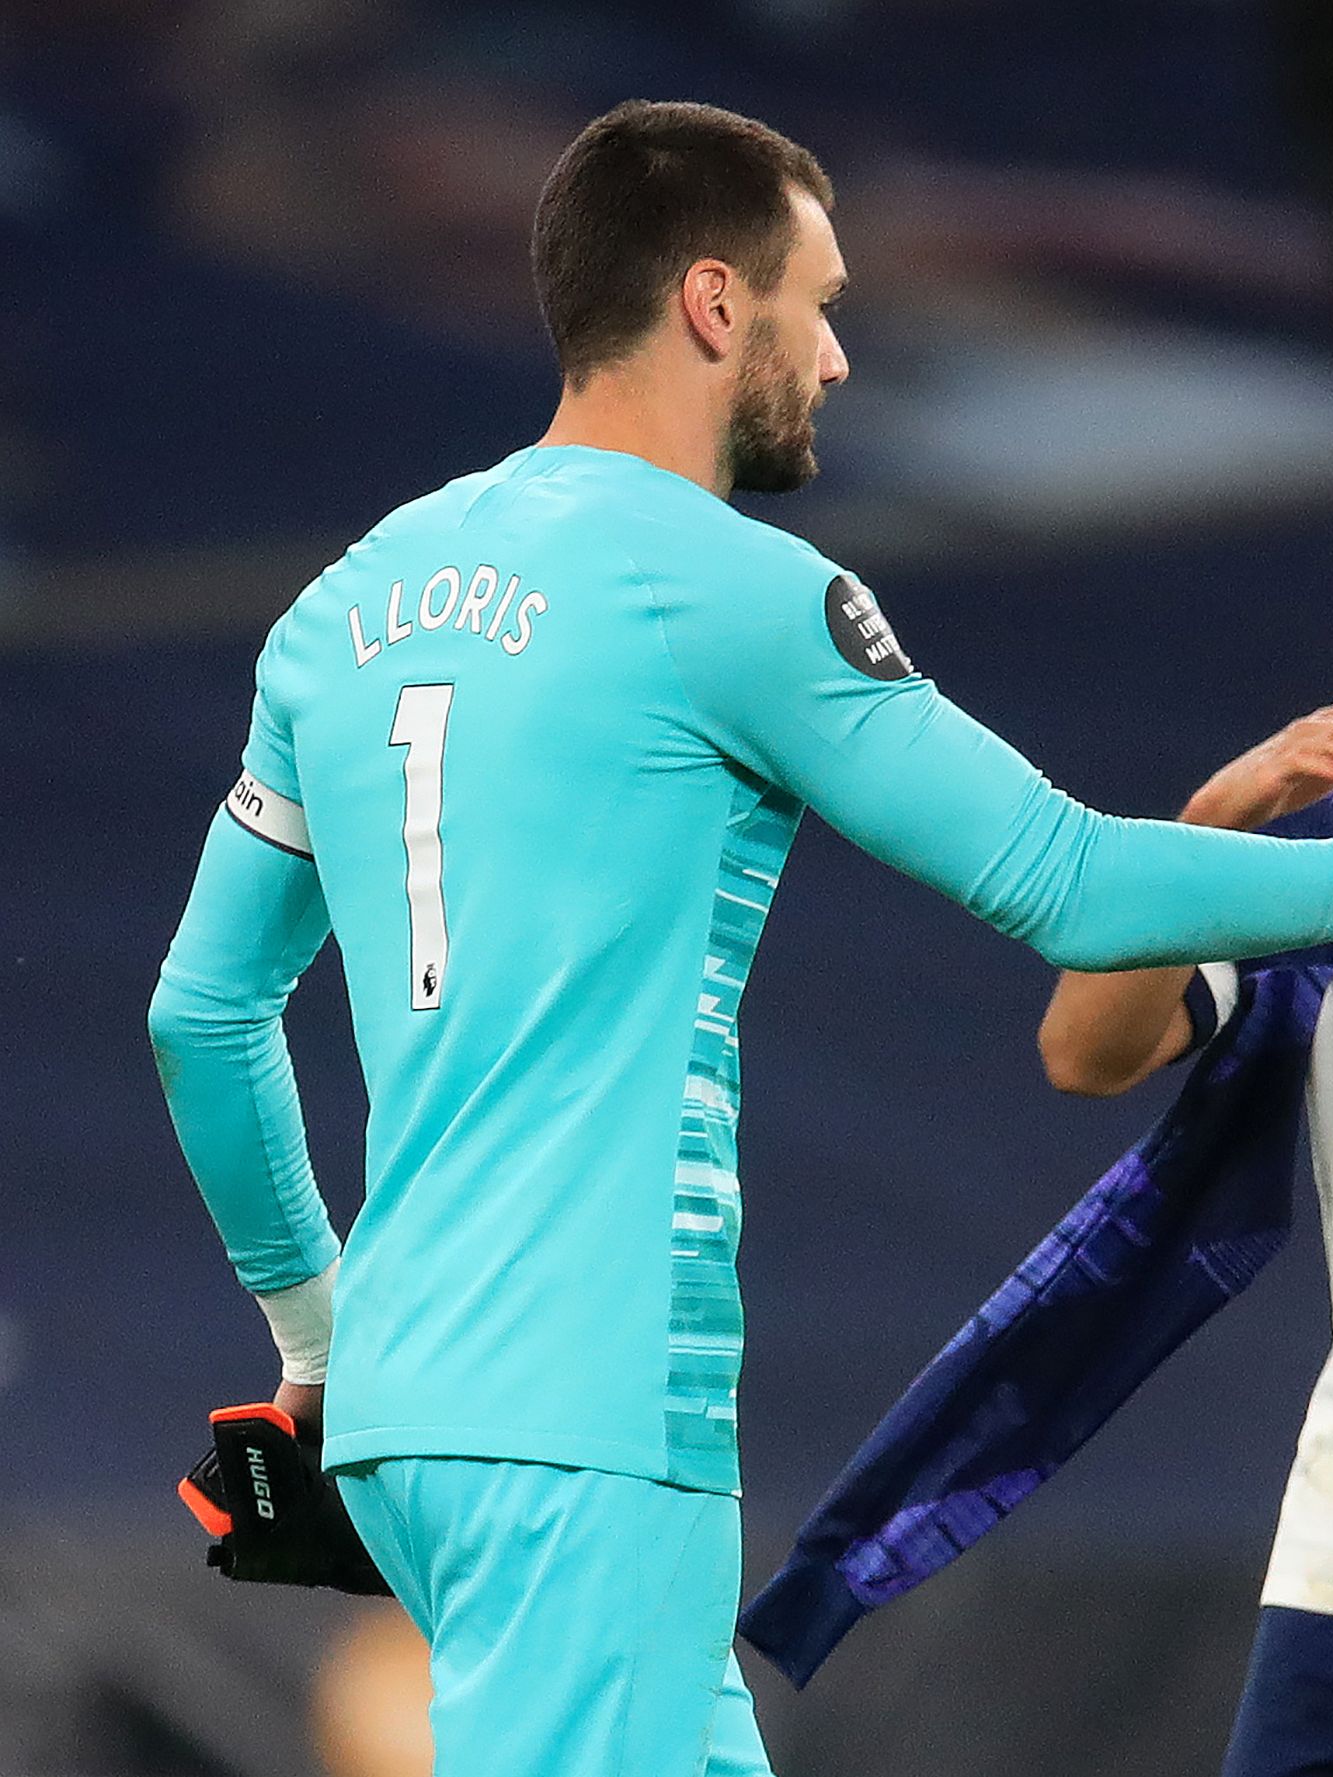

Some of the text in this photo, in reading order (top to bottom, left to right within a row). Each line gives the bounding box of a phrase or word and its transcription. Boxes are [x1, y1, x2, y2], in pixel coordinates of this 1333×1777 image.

[348, 563, 549, 669] LLORIS
[388, 682, 454, 1011] 1
[246, 1446, 275, 1520] HUGO
